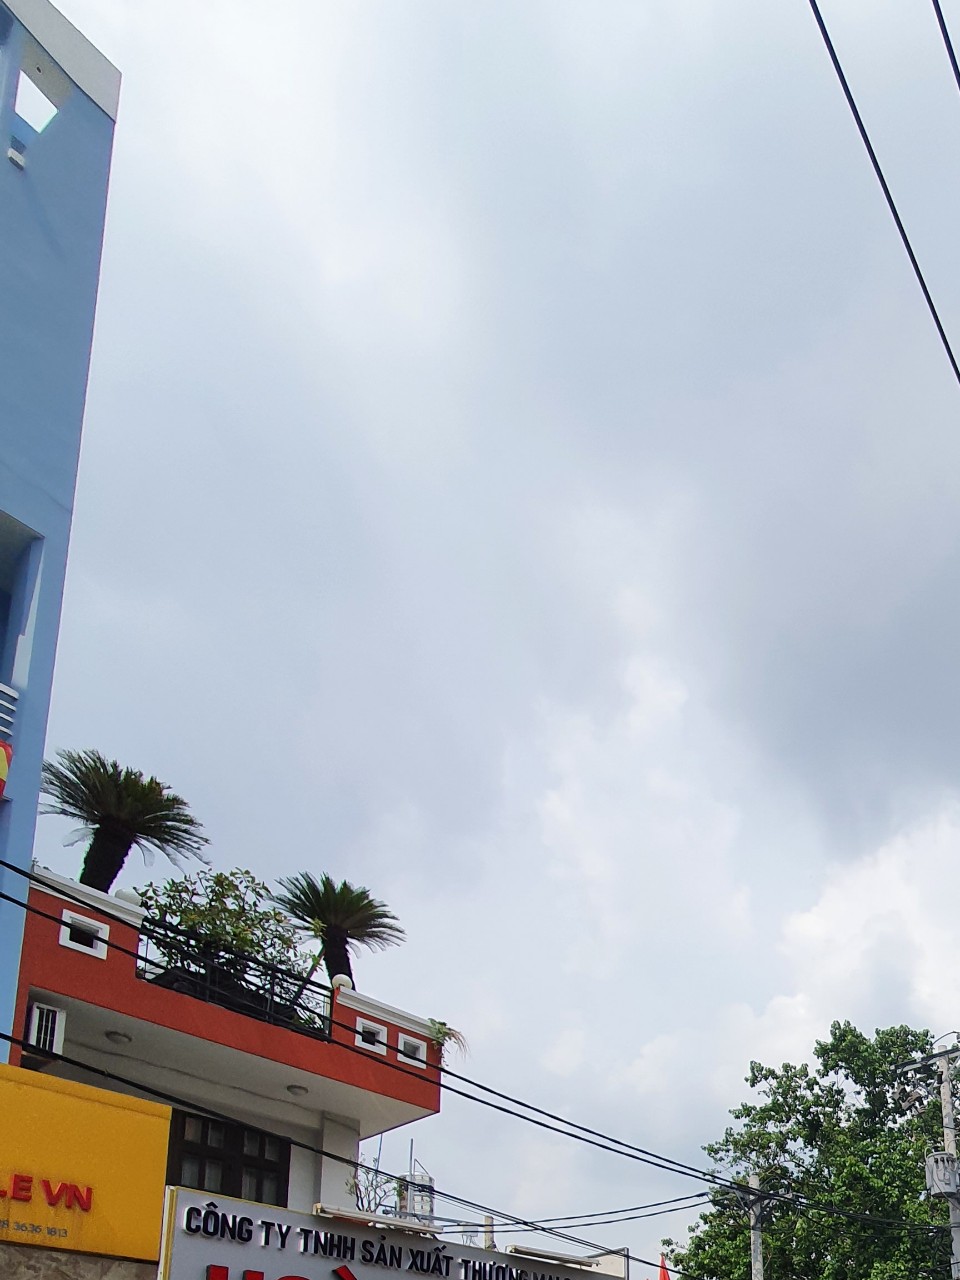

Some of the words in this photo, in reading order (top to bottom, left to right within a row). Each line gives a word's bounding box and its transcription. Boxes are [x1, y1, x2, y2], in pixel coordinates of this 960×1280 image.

[0, 1173, 33, 1202] E
[41, 1179, 93, 1212] VN
[184, 1201, 254, 1244] CÔNG
[258, 1219, 292, 1250] TY
[297, 1226, 356, 1262] TNHH
[360, 1234, 403, 1269] SẢN
[407, 1245, 454, 1278] XUẤT
